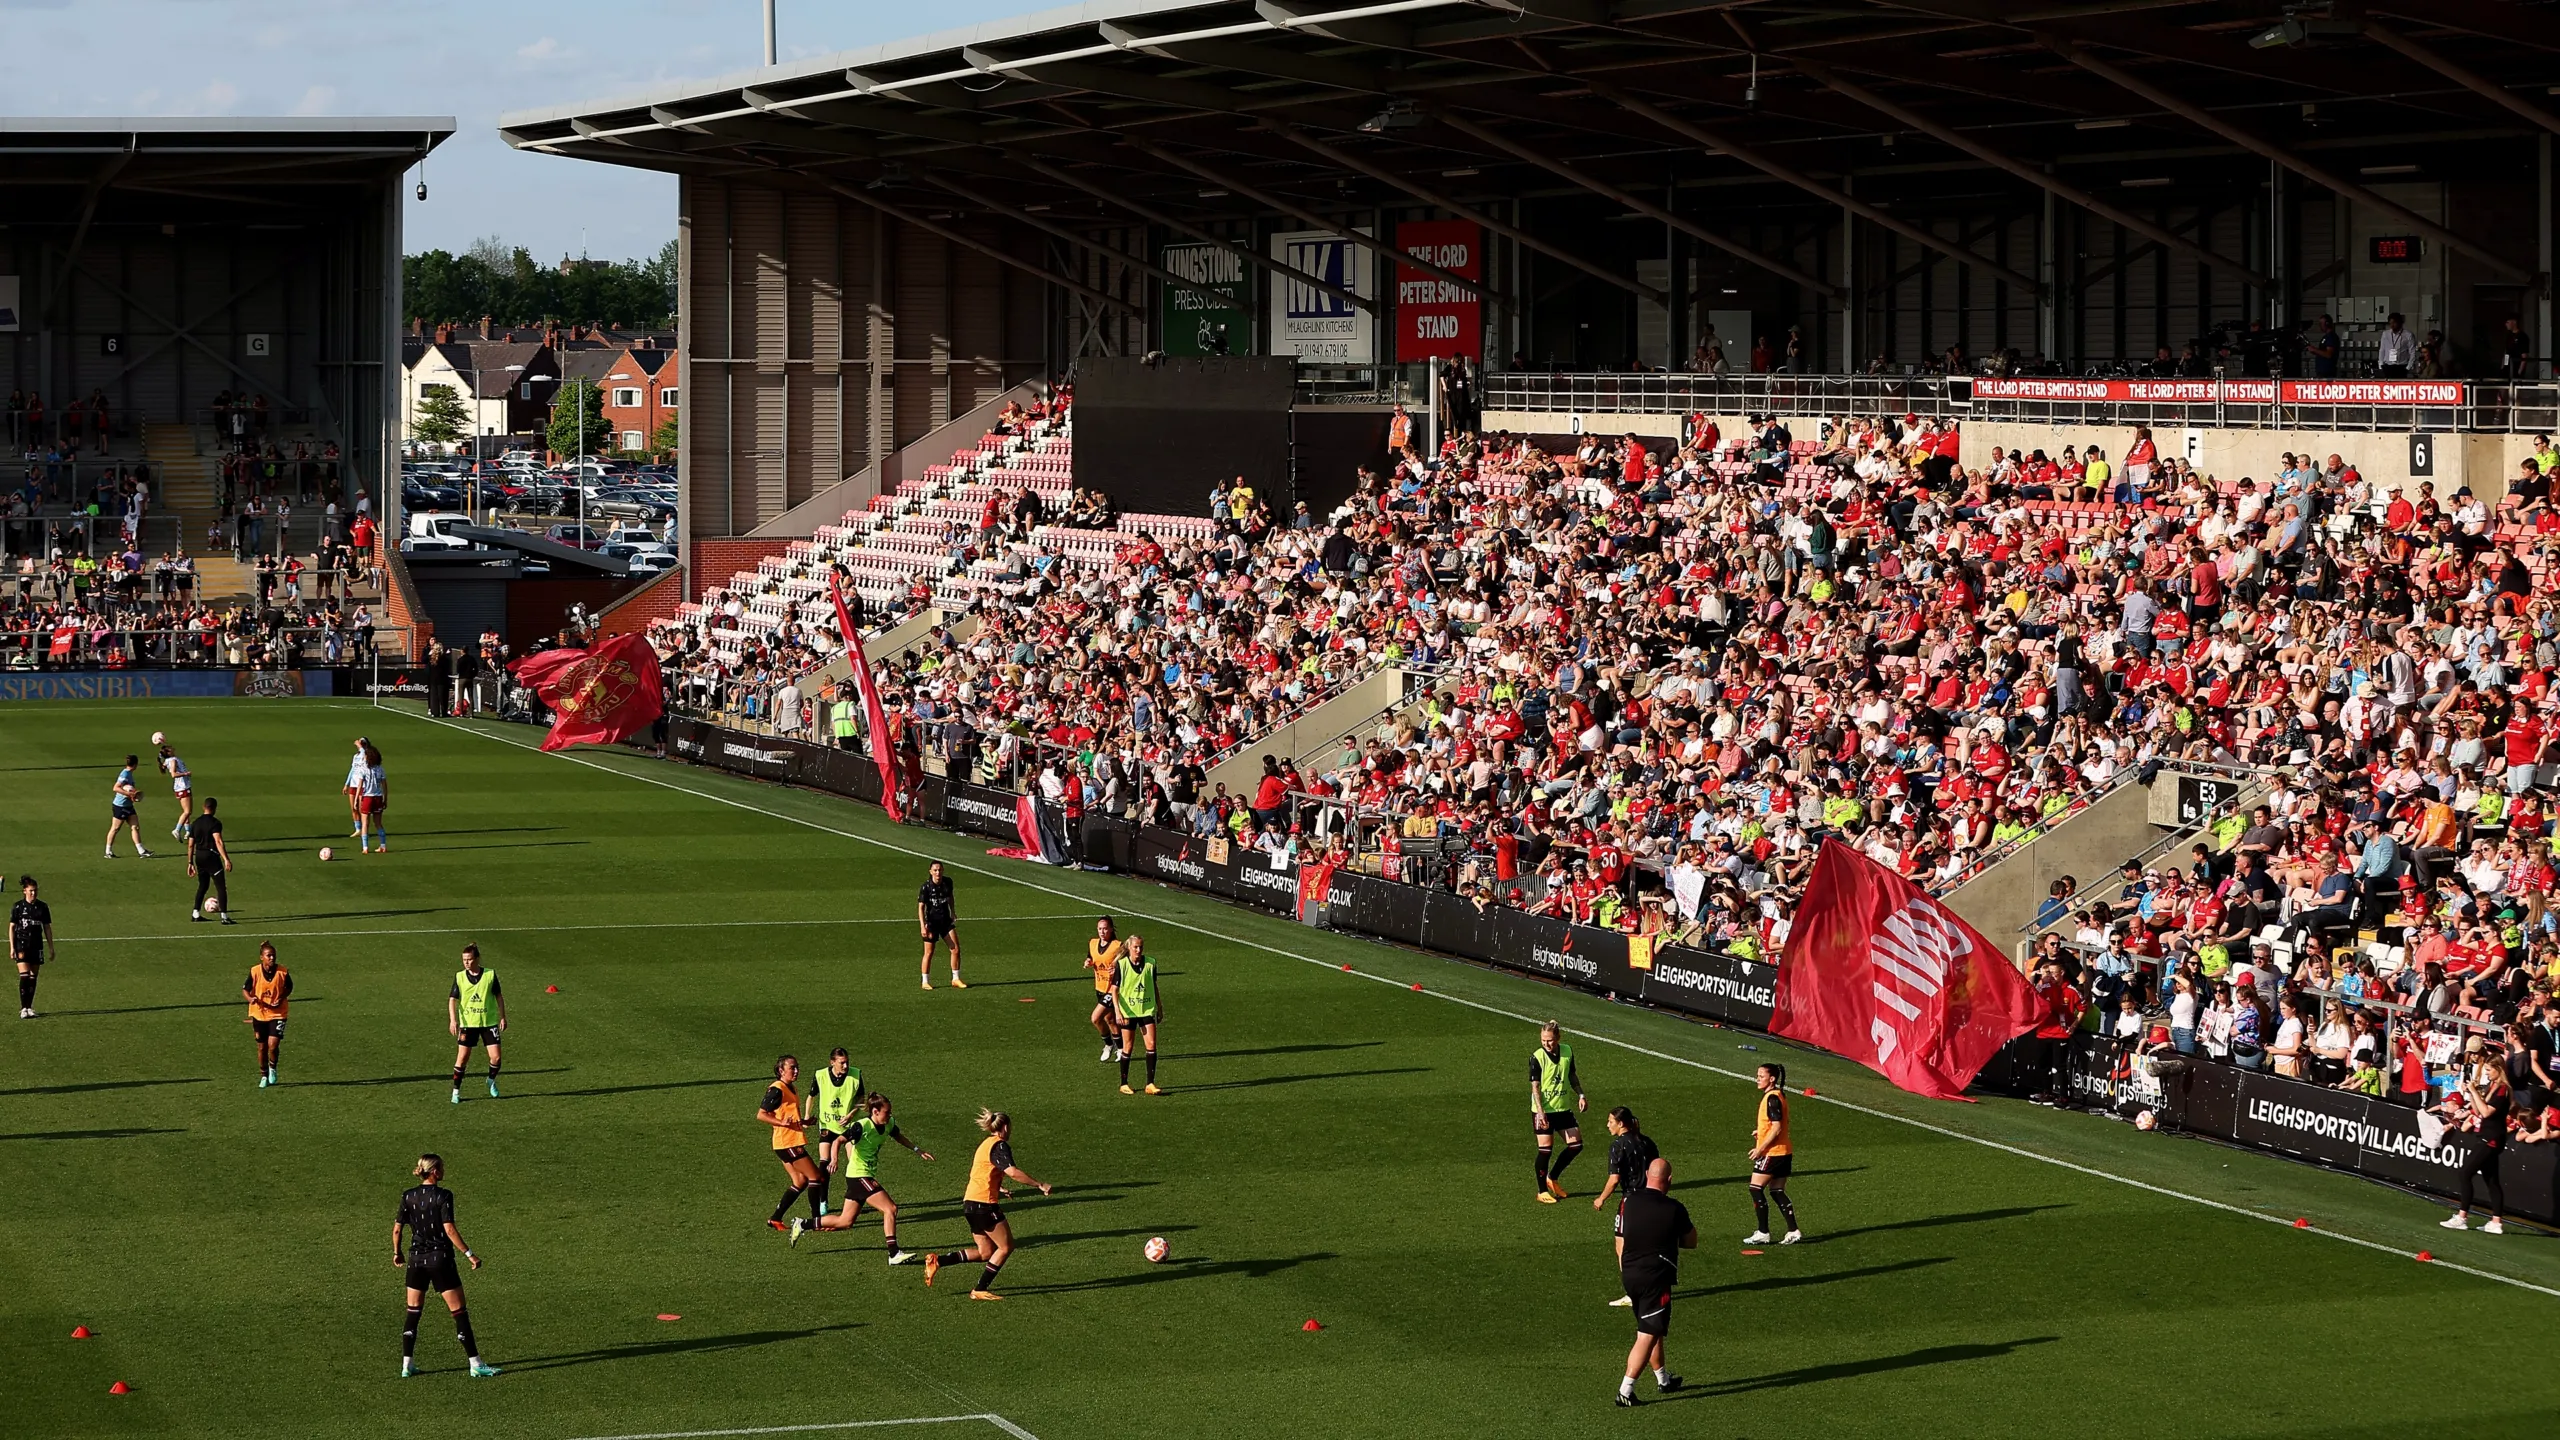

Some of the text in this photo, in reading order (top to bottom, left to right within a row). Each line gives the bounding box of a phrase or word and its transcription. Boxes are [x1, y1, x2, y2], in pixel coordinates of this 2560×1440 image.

[1166, 246, 1243, 285] KINGSTONE
[1434, 244, 1468, 268] LORD
[1288, 243, 1332, 313] MK
[1174, 289, 1204, 311] PRESS
[1400, 281, 1437, 304] PETER
[1325, 320, 1354, 333] KITCHENS
[1417, 315, 1459, 339] STAND
[107, 338, 117, 352] 6
[251, 337, 264, 352] G
[1976, 380, 2108, 398] THE LORD PETER SMITH STAND
[2128, 383, 2273, 399] THE LORD PETER SMTH STAND
[2295, 384, 2457, 401] THE LORD PETER SMITH STAND
[1572, 416, 1580, 434] D
[1685, 422, 1692, 441] 4
[2187, 436, 2197, 460] F
[2415, 442, 2426, 467] 6
[0, 675, 159, 701] SPONSIBLY
[244, 677, 293, 695] CHIVAS
[366, 682, 429, 693] leighsportsvillag
[2199, 781, 2217, 803] E3
[946, 795, 1018, 825] LEIGHSPORTSVILLAGE.CO
[1532, 943, 1598, 978] leighsportsvillage
